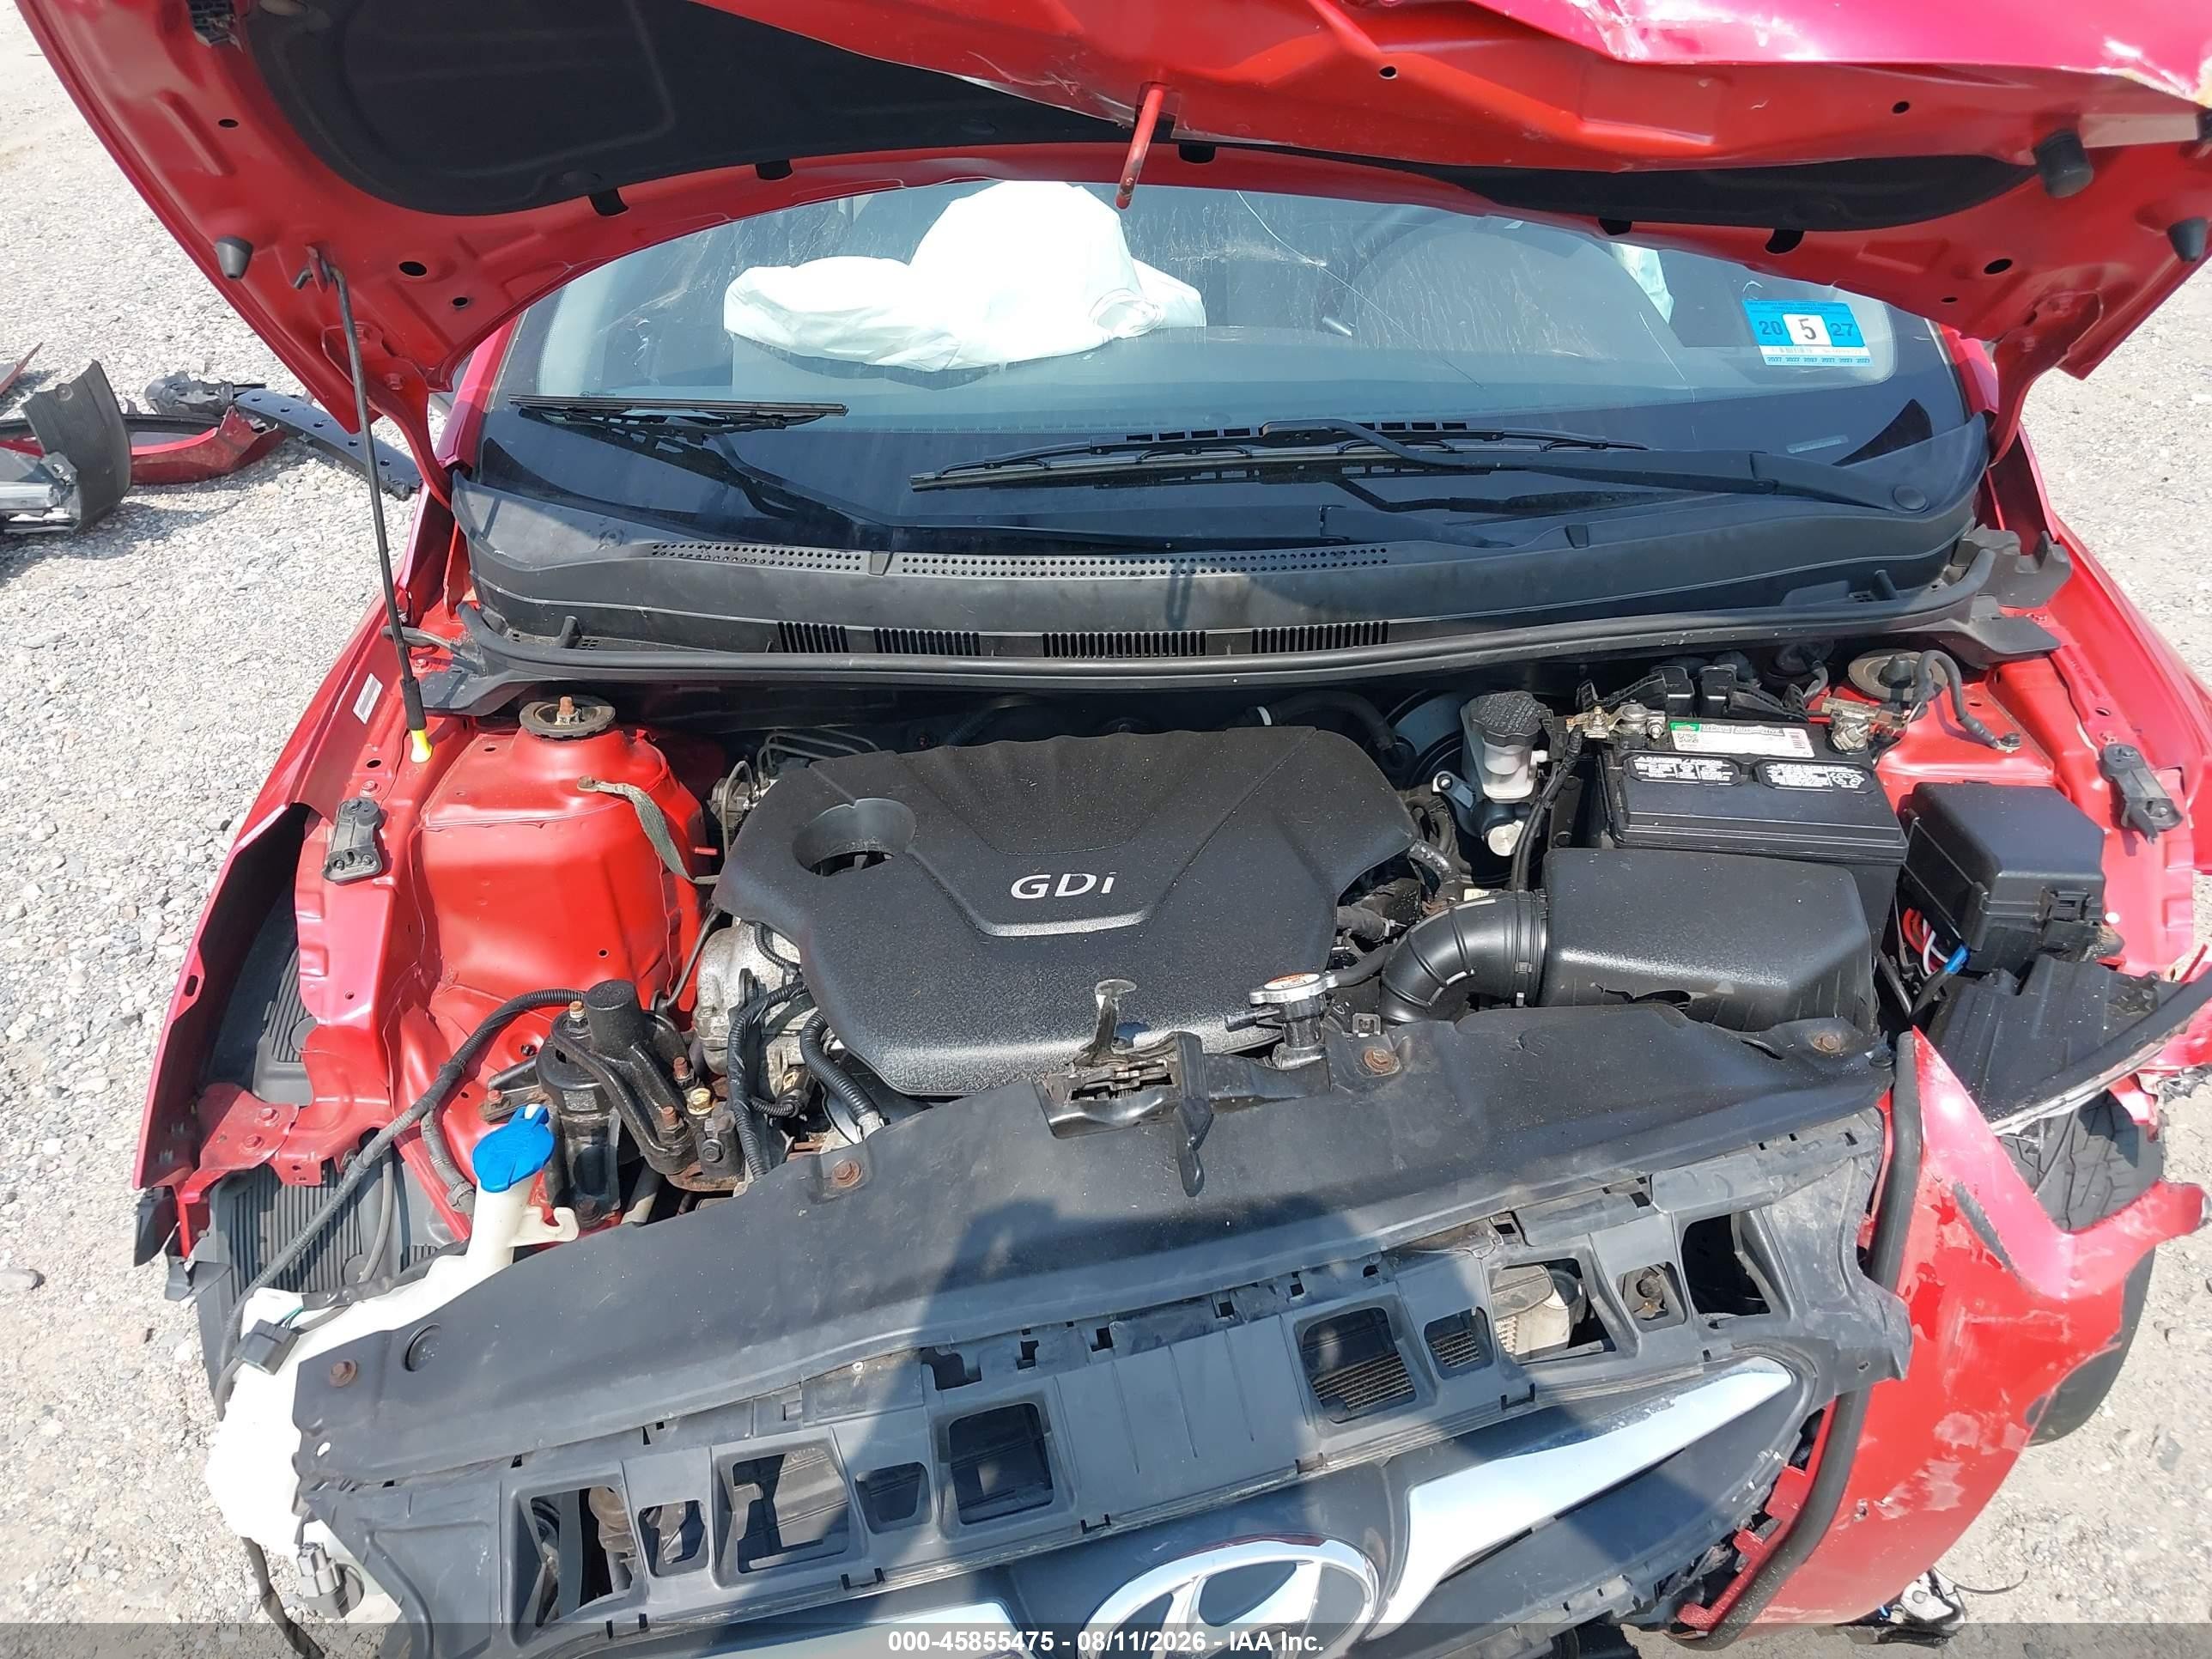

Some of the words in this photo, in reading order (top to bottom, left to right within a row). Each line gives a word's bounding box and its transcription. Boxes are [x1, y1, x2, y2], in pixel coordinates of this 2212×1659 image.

[1759, 320, 1783, 336] 20
[1798, 318, 1816, 340] 5
[1830, 323, 1854, 337] 27
[1011, 872, 1116, 899] GDi
